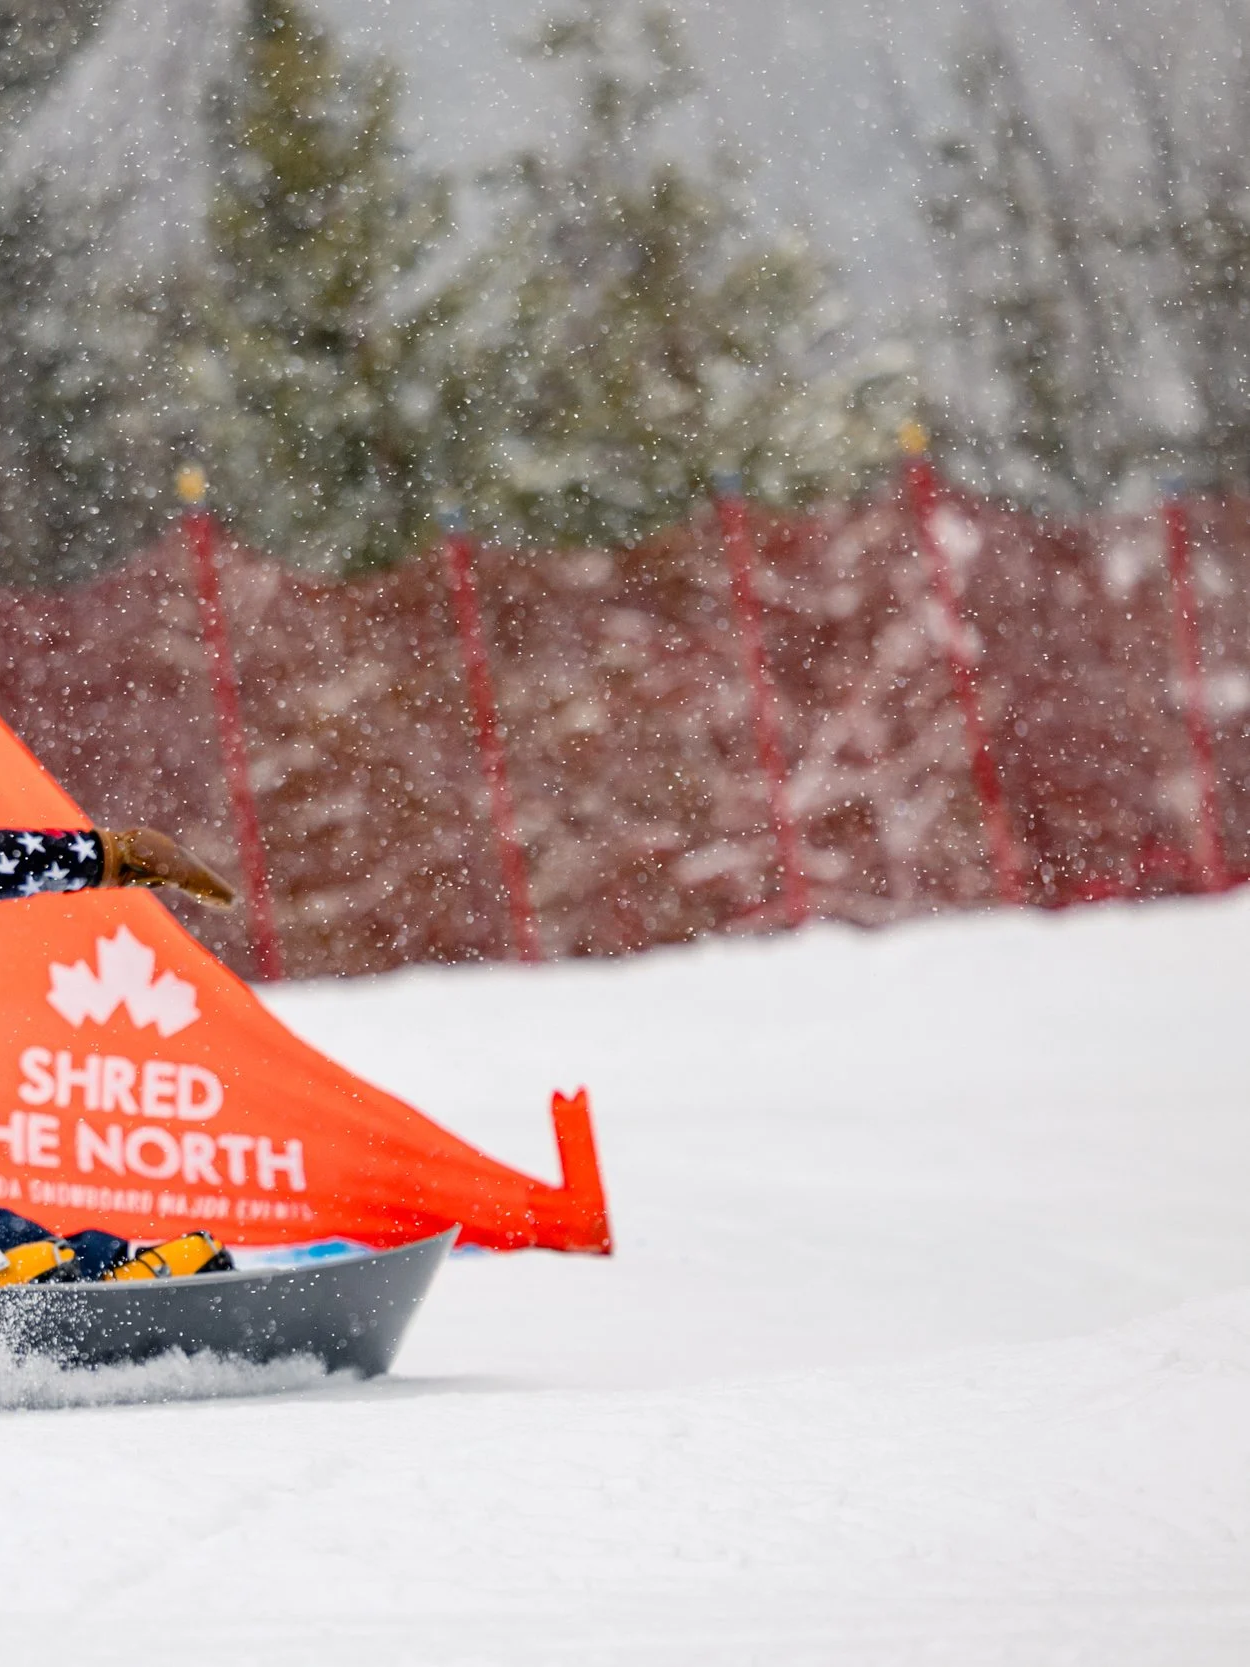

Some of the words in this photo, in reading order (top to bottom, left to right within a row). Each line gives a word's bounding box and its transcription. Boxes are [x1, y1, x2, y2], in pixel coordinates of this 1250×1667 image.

[17, 1045, 225, 1122] SHRED
[74, 1120, 308, 1193] NORTH
[27, 1177, 154, 1216] SNOWBOARD
[157, 1191, 231, 1220] MAJOR
